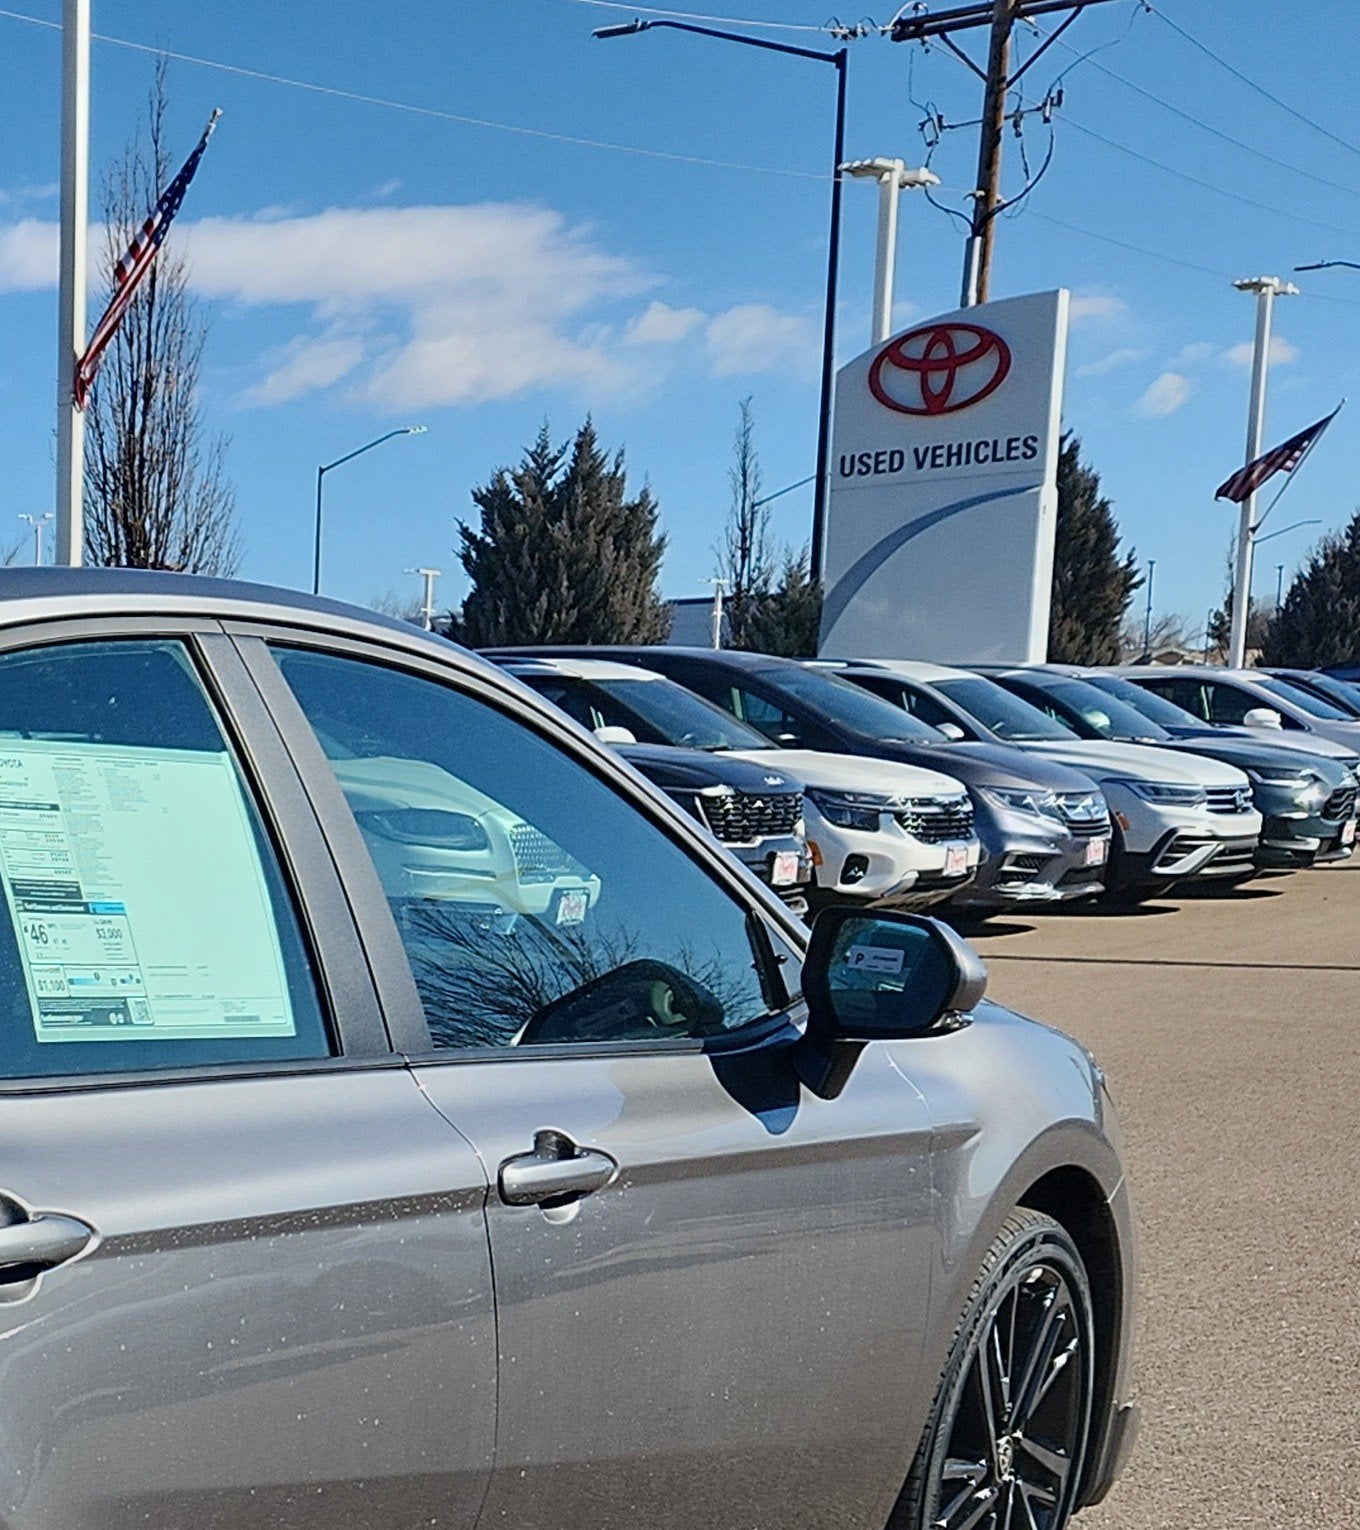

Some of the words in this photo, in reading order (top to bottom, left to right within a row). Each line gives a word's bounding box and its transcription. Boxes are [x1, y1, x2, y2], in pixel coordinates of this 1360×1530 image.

[839, 448, 905, 478] USED
[912, 434, 1039, 471] VEHICLES
[29, 923, 49, 946] 46
